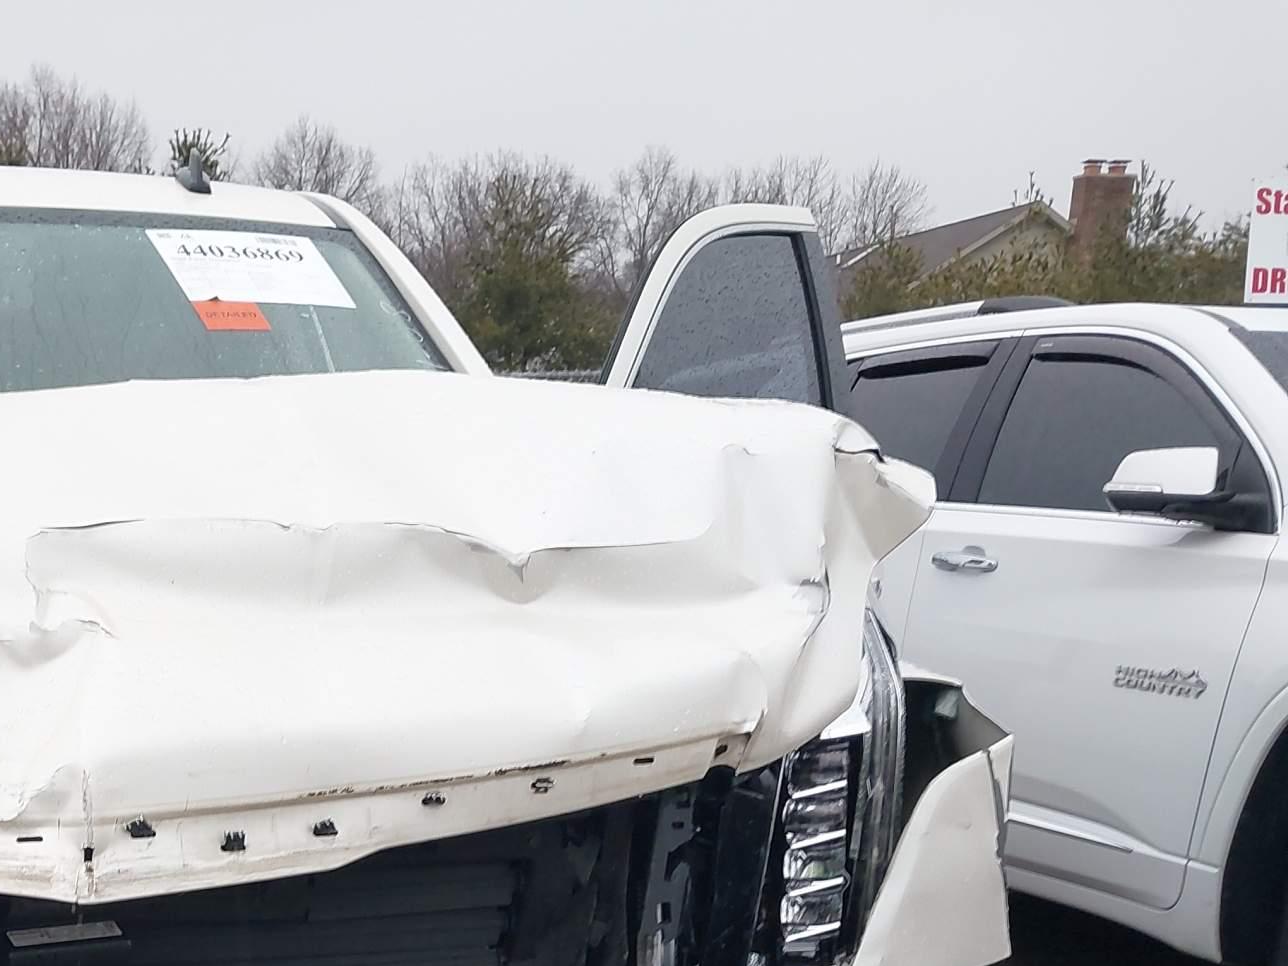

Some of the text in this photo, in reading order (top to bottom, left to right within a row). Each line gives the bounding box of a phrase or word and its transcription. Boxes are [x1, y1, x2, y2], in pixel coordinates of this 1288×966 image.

[177, 243, 304, 262] 44036869
[1115, 665, 1162, 681] HIGH
[1113, 678, 1208, 699] COUNTRY
